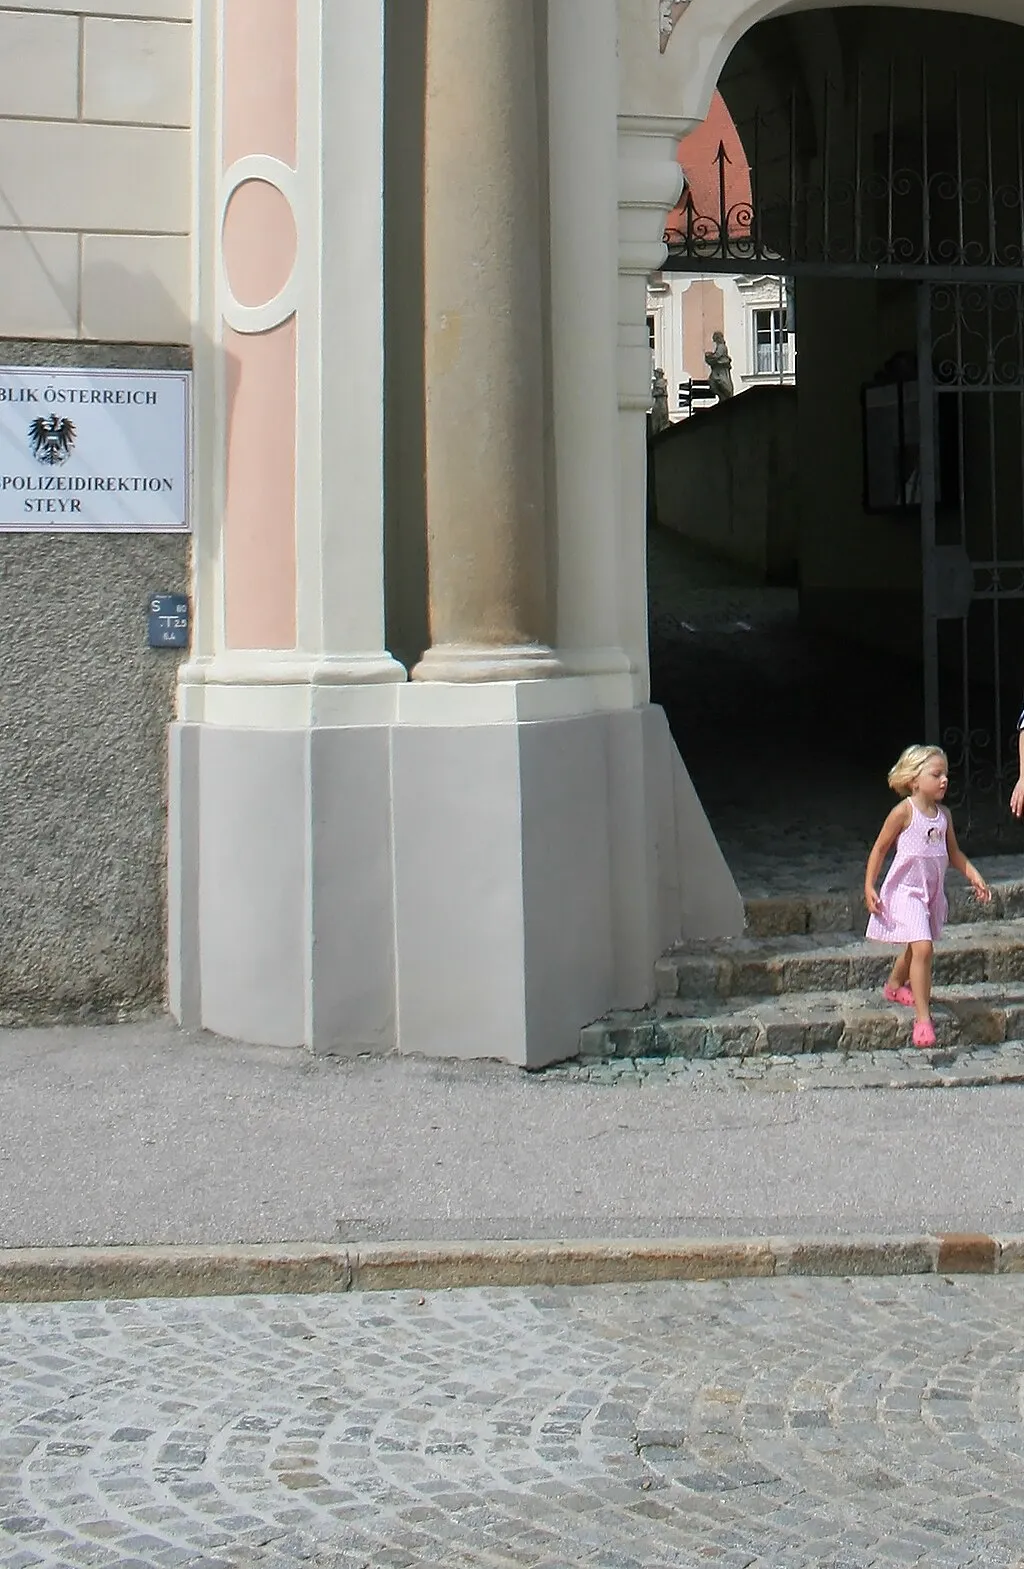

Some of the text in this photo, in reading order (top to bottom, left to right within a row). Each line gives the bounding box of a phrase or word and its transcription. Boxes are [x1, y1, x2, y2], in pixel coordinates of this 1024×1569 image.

[44, 385, 158, 405] ÖSTERREICH
[0, 476, 174, 492] POLIZEIDIREKTION
[24, 498, 82, 513] STEYR
[151, 600, 161, 612] S
